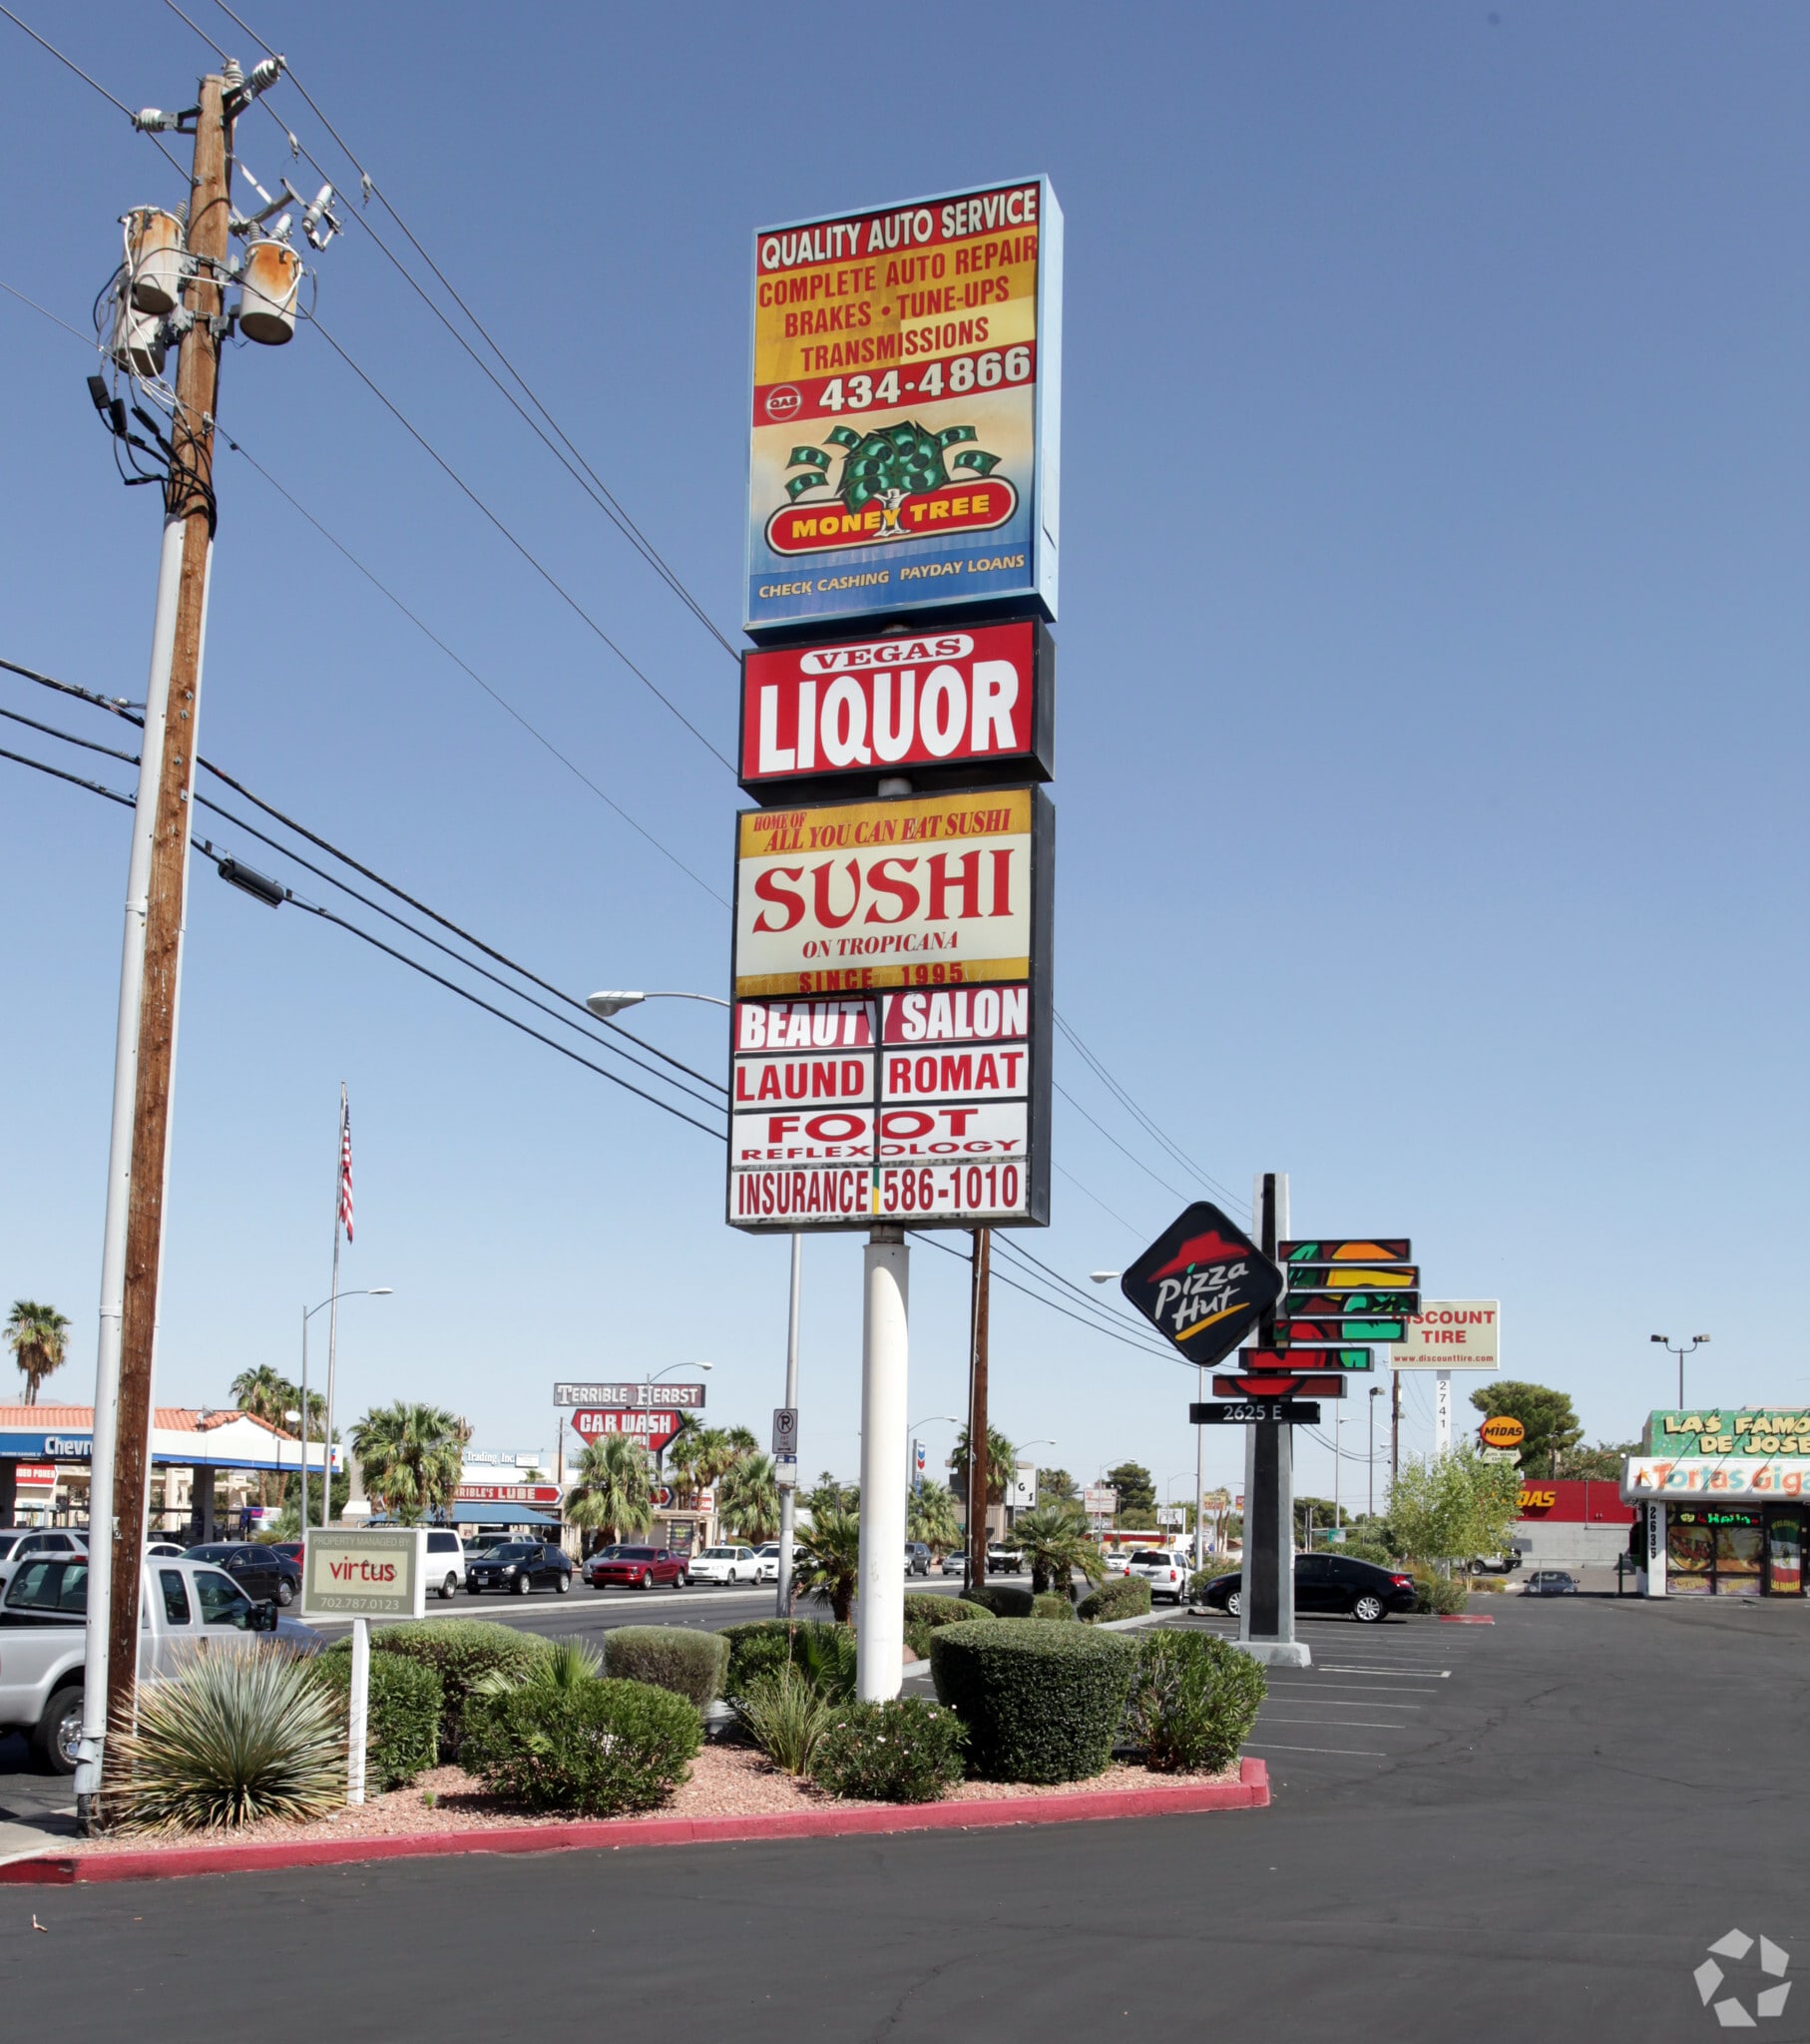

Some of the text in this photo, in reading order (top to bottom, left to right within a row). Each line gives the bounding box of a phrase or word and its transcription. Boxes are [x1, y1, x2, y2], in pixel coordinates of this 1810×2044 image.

[761, 189, 1037, 271] QUALITY AUTO SERVICE
[758, 235, 1038, 307] COMPLETE AUTO REPAIR
[784, 275, 1009, 338] BRAKES TUNE-UPS
[800, 316, 989, 372] TRANSMISSIONS
[792, 494, 990, 539] MONEY TREE
[758, 555, 1025, 599] CHECK CASHING PAYDAY LOANS
[813, 638, 962, 669] VEGAS
[758, 660, 1019, 773] LIQUOR
[753, 811, 806, 832] HOME OF
[763, 808, 1012, 852] ALL YOU CAN EAT SUSHI
[752, 848, 1015, 934] SUSHI
[802, 930, 958, 959] ON TROPICANA
[799, 962, 963, 993] SINCE 1995
[901, 988, 1028, 1041] SALON
[768, 1109, 978, 1143] FOOT
[738, 1165, 1019, 1216] INSURANCE 586-1010
[1155, 1263, 1249, 1320] Pizza
[1171, 1285, 1240, 1330] Hut
[1393, 1310, 1495, 1324] ISCOUNT
[1421, 1330, 1467, 1343] TIRE
[557, 1384, 698, 1405] TERRIBLE HERBST
[580, 1413, 672, 1433] CAR WASH
[1222, 1405, 1282, 1421] 2625 E
[1664, 1415, 1721, 1434] LAS
[1699, 1435, 1810, 1453] DE JOSE
[1652, 1463, 1744, 1490] Tortas
[498, 1487, 535, 1500] LUBE
[312, 1536, 355, 1546] PROPERTY
[356, 1537, 397, 1546] MANAGED
[329, 1556, 395, 1581] virtus
[320, 1598, 399, 1610] 702.787.0123
